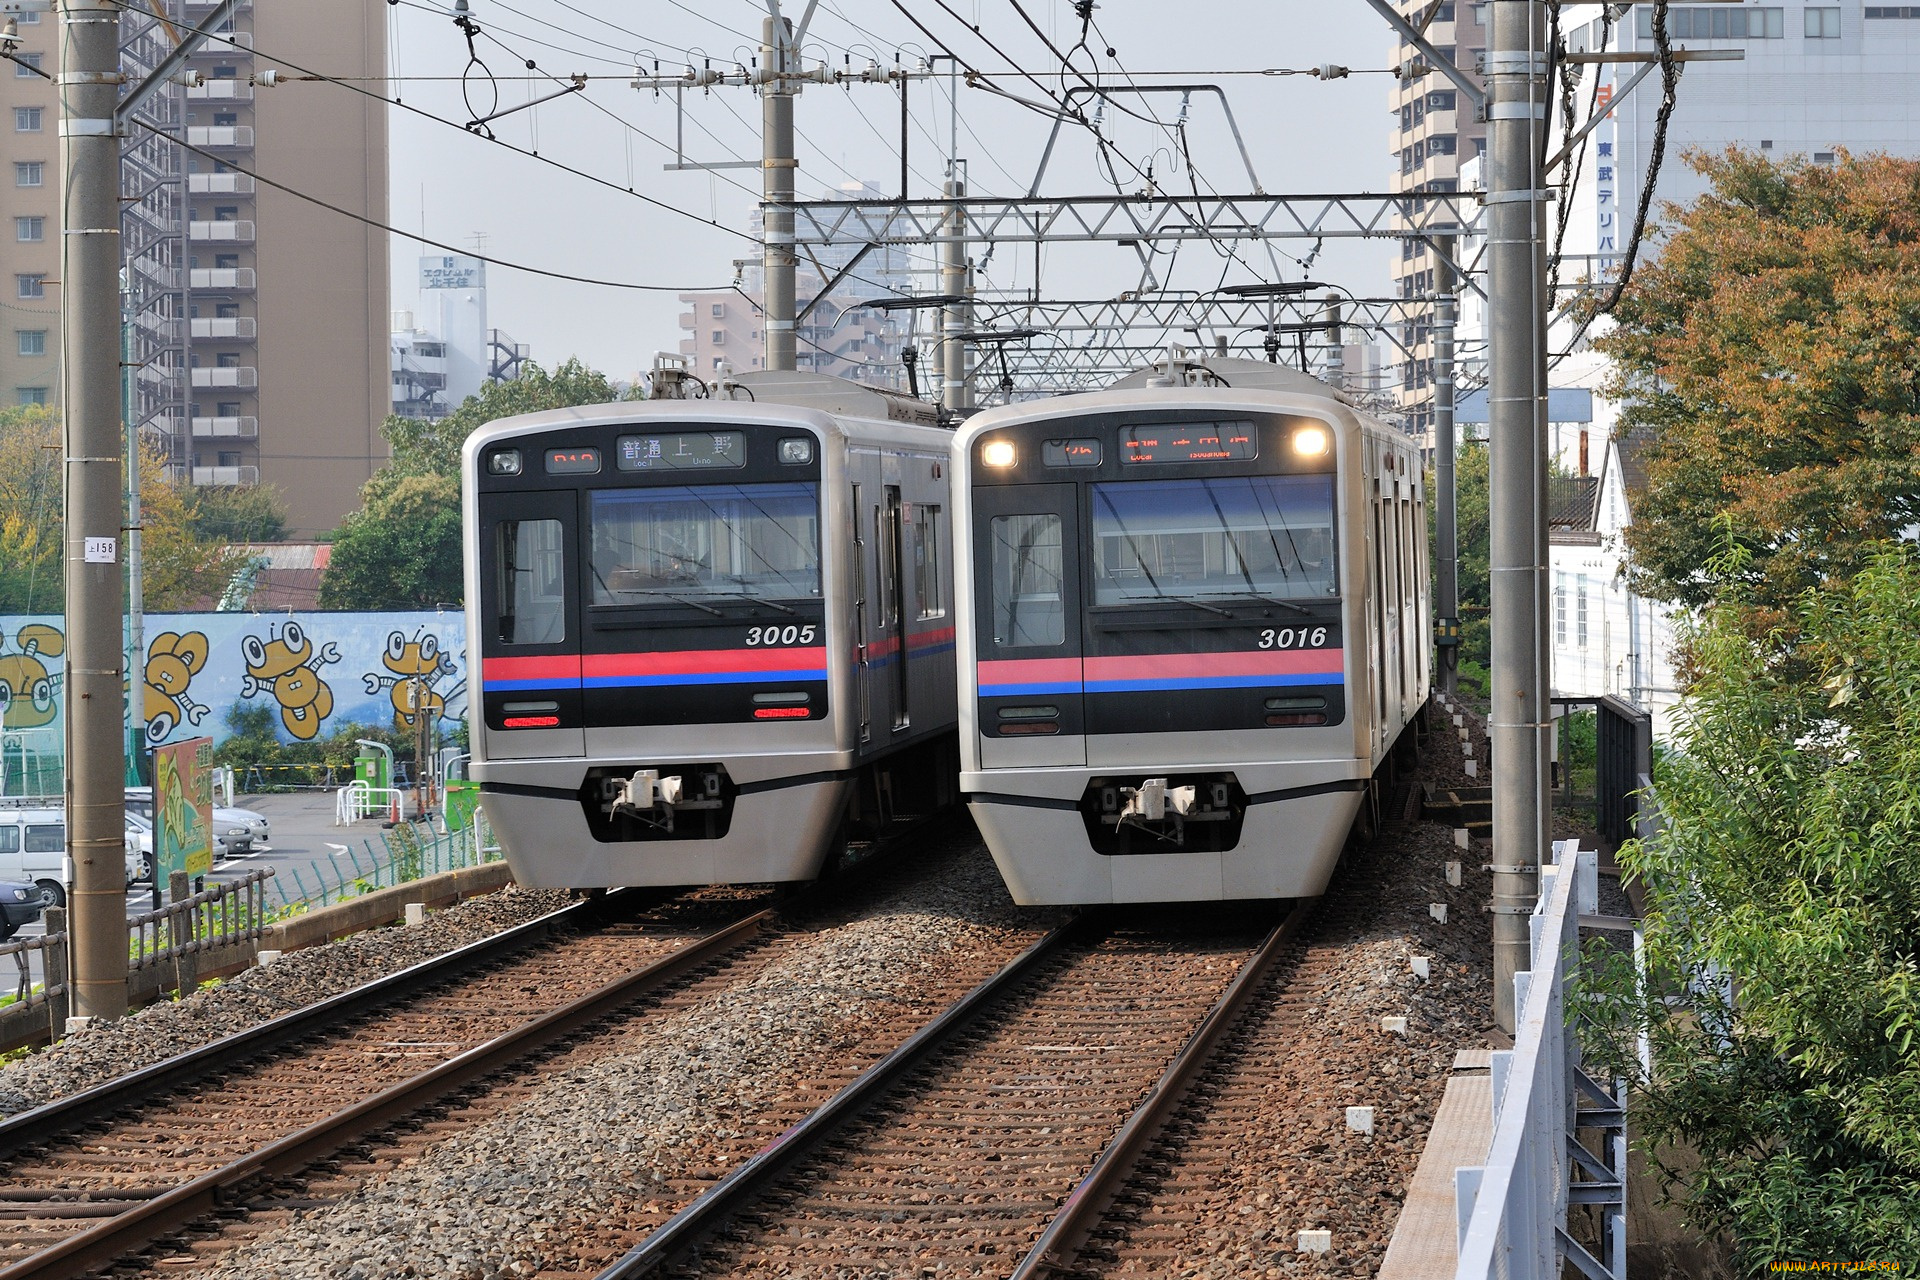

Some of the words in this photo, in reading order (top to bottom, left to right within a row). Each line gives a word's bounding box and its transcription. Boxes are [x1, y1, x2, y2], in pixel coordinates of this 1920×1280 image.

[429, 277, 470, 288] 北千住
[745, 624, 817, 647] 3005
[1258, 626, 1327, 649] 3016
